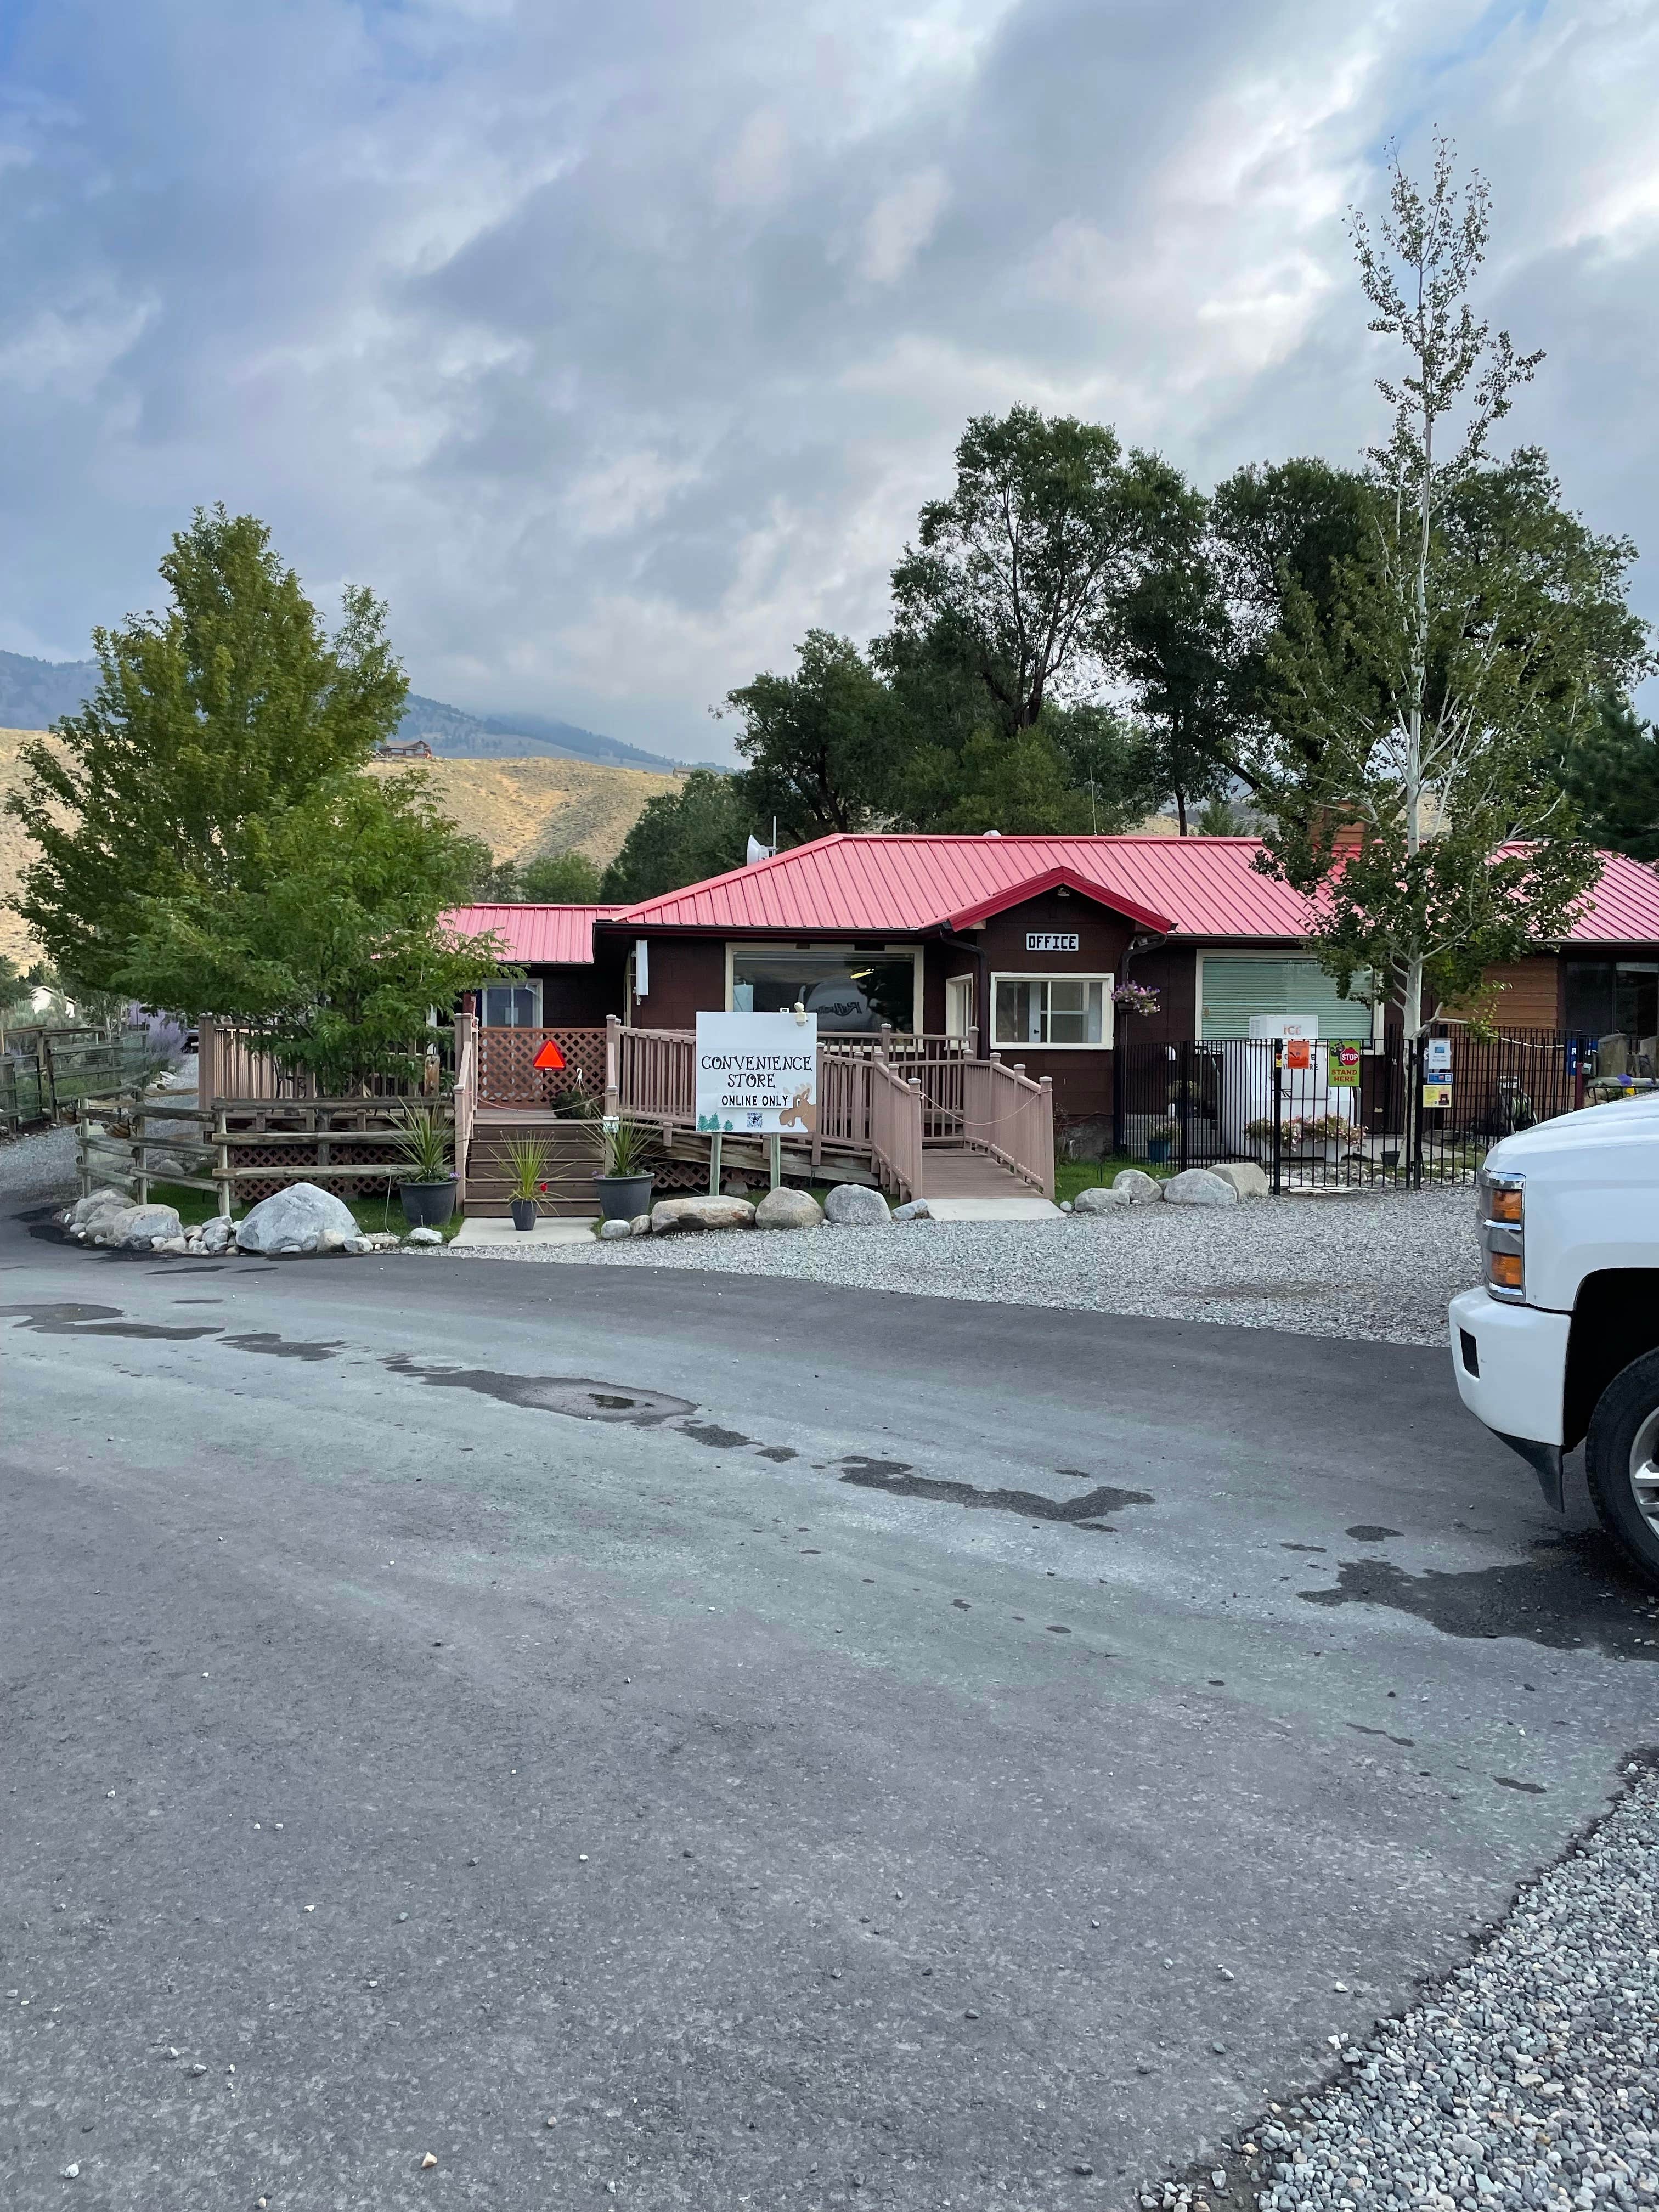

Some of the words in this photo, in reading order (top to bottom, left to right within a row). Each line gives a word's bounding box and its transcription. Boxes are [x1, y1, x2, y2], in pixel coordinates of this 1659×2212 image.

[1029, 935, 1076, 949] OFFICE
[1283, 1024, 1301, 1035] ICE
[701, 1055, 812, 1071] CONVENIENCE
[727, 1073, 776, 1088] STORE
[721, 1095, 757, 1106] ONLINE
[762, 1095, 789, 1107] ONLY
